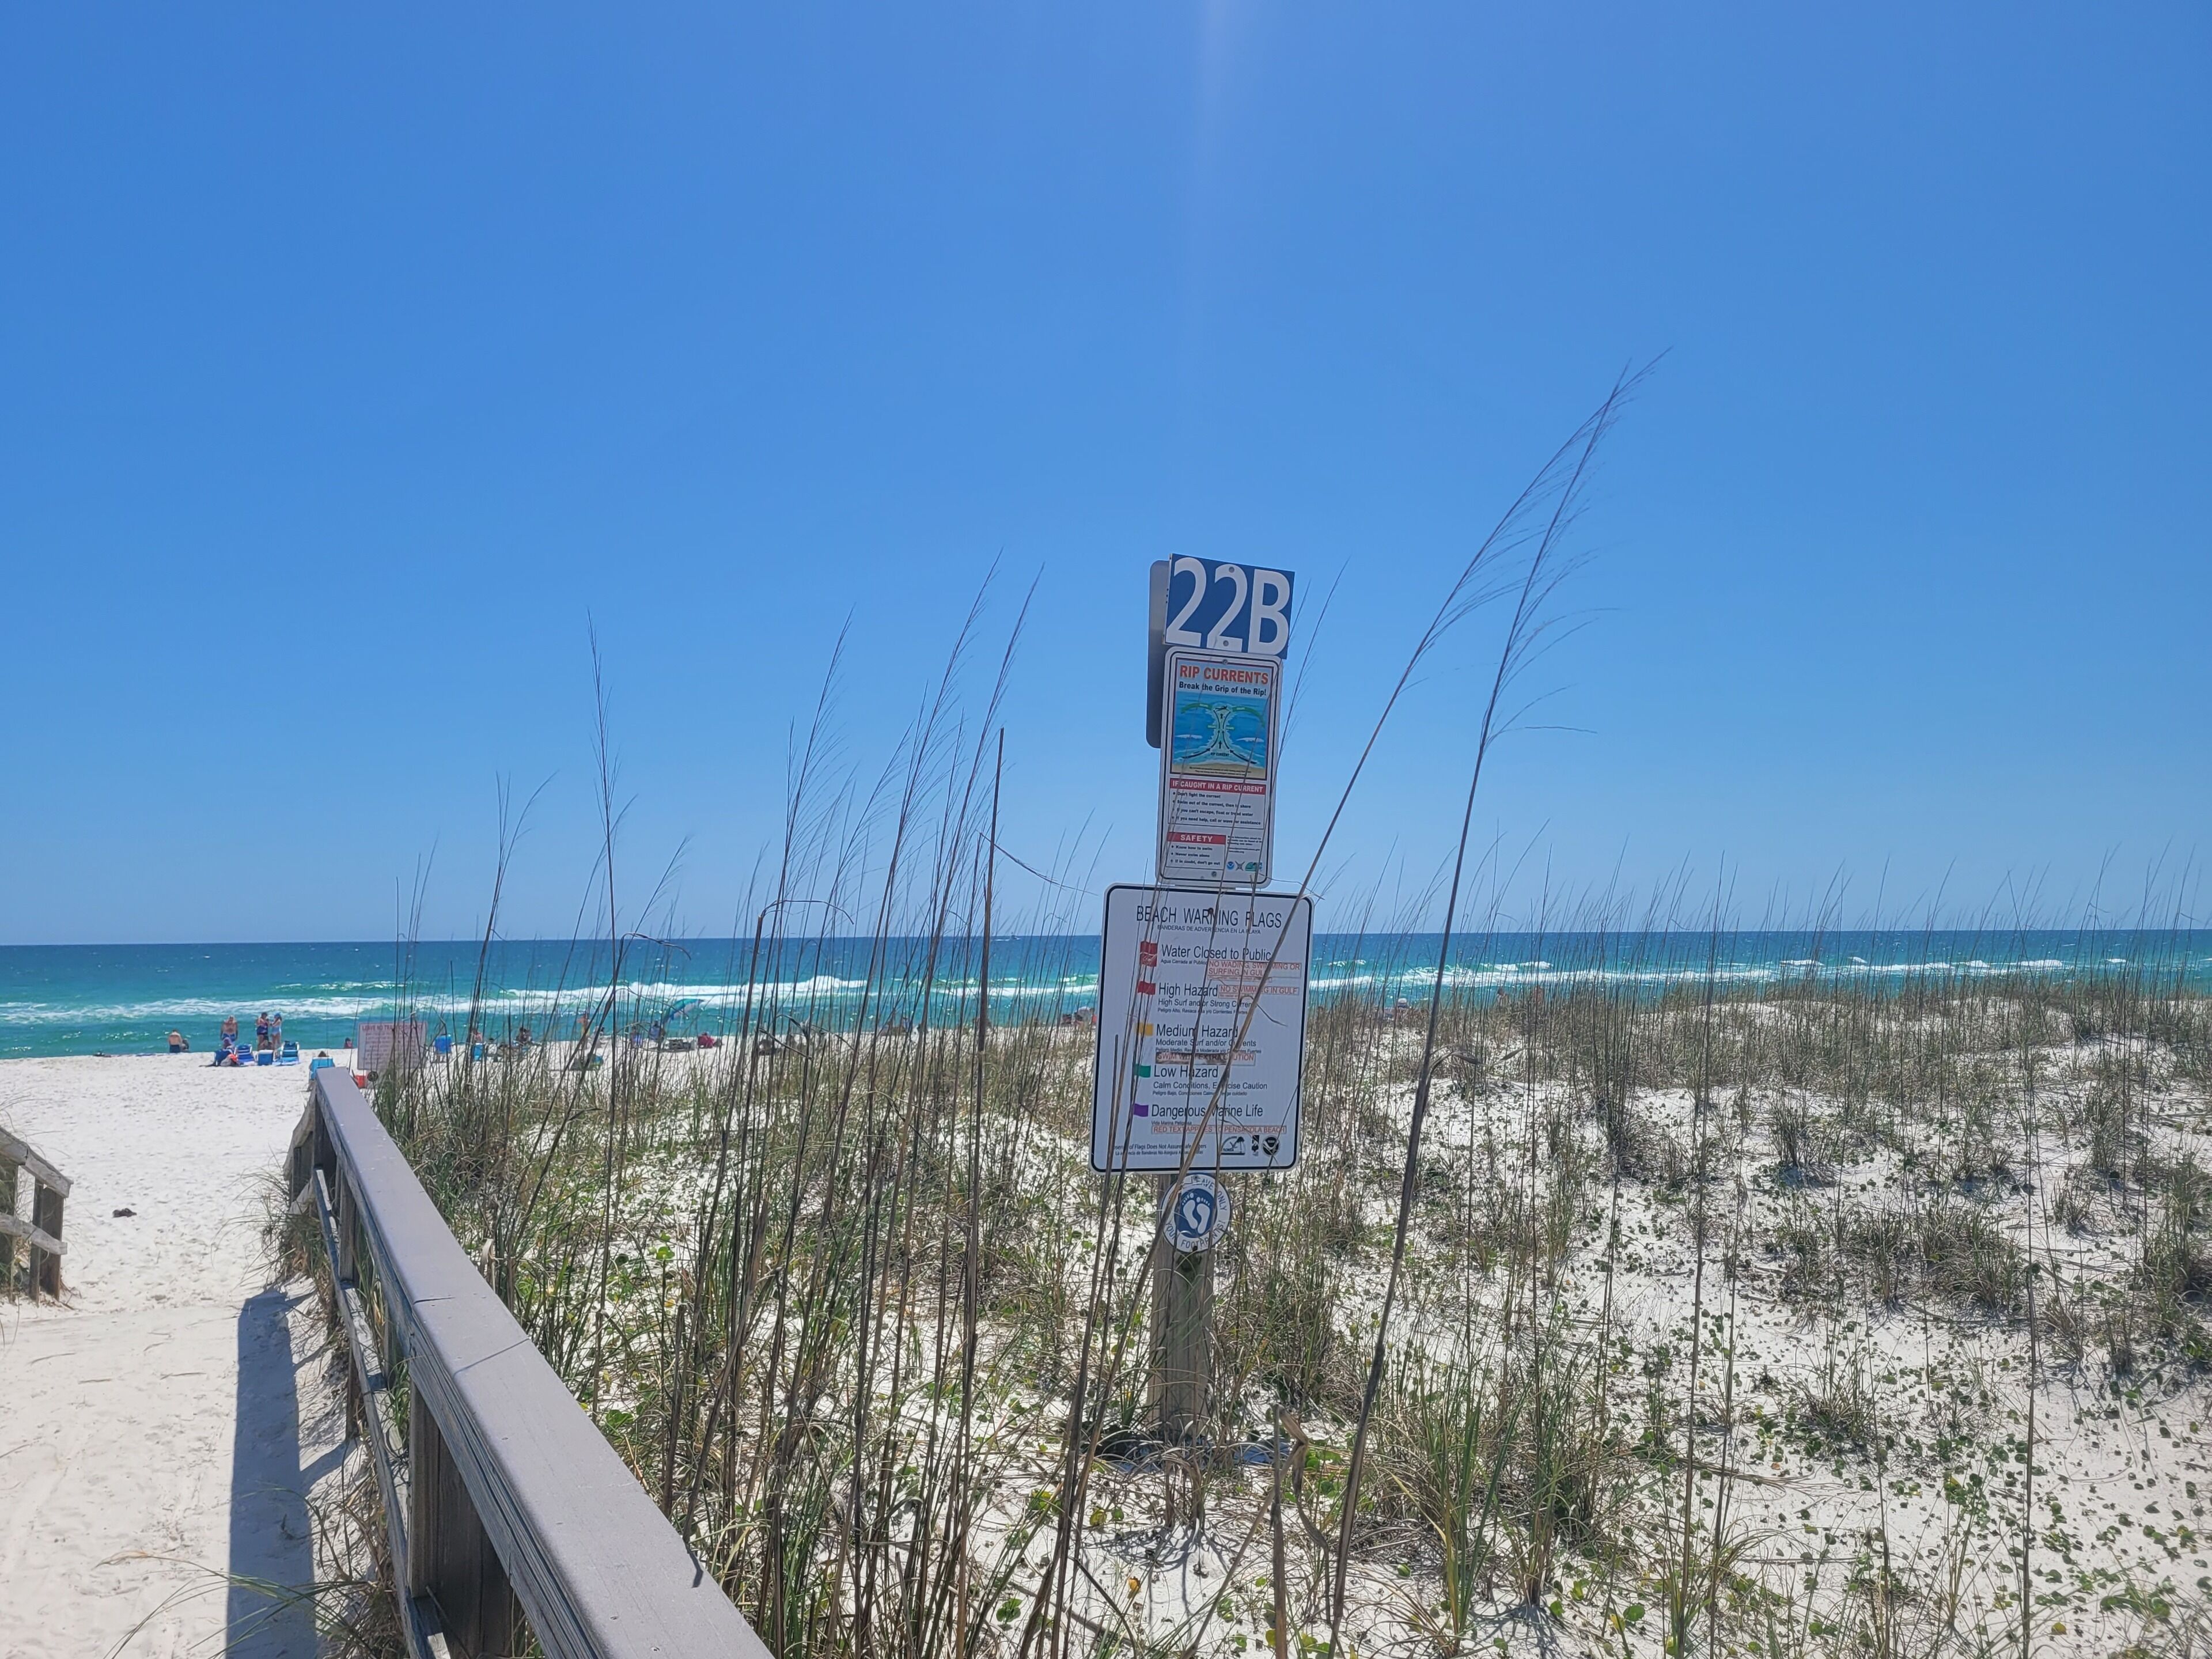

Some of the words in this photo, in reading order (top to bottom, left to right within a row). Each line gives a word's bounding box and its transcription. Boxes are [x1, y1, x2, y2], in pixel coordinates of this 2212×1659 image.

[1165, 556, 1290, 656] 22B
[1180, 665, 1199, 678] RIP
[1204, 667, 1268, 684] CURRENTS
[1179, 681, 1199, 690] Break
[1215, 685, 1229, 694] Grip
[1253, 688, 1266, 696] Rip!
[1137, 906, 1176, 923] BEACH
[1184, 908, 1238, 926] WARNING
[1245, 911, 1282, 928] FLAGS
[1161, 944, 1191, 957] Water
[1194, 946, 1227, 959] Closed
[1230, 948, 1239, 959] to
[1243, 948, 1271, 961] Public
[1159, 982, 1180, 998] High
[1184, 983, 1218, 997] Hazard
[1158, 998, 1172, 1007] High
[1210, 1000, 1230, 1009] Strong
[1202, 1025, 1238, 1037] Hazard
[1154, 1065, 1177, 1077] Low
[1152, 1104, 1206, 1120] Dangerous
[1246, 1104, 1263, 1117] Life
[1217, 1191, 1227, 1211] ONLY
[1181, 1219, 1225, 1249] FOOTPRNTS!
